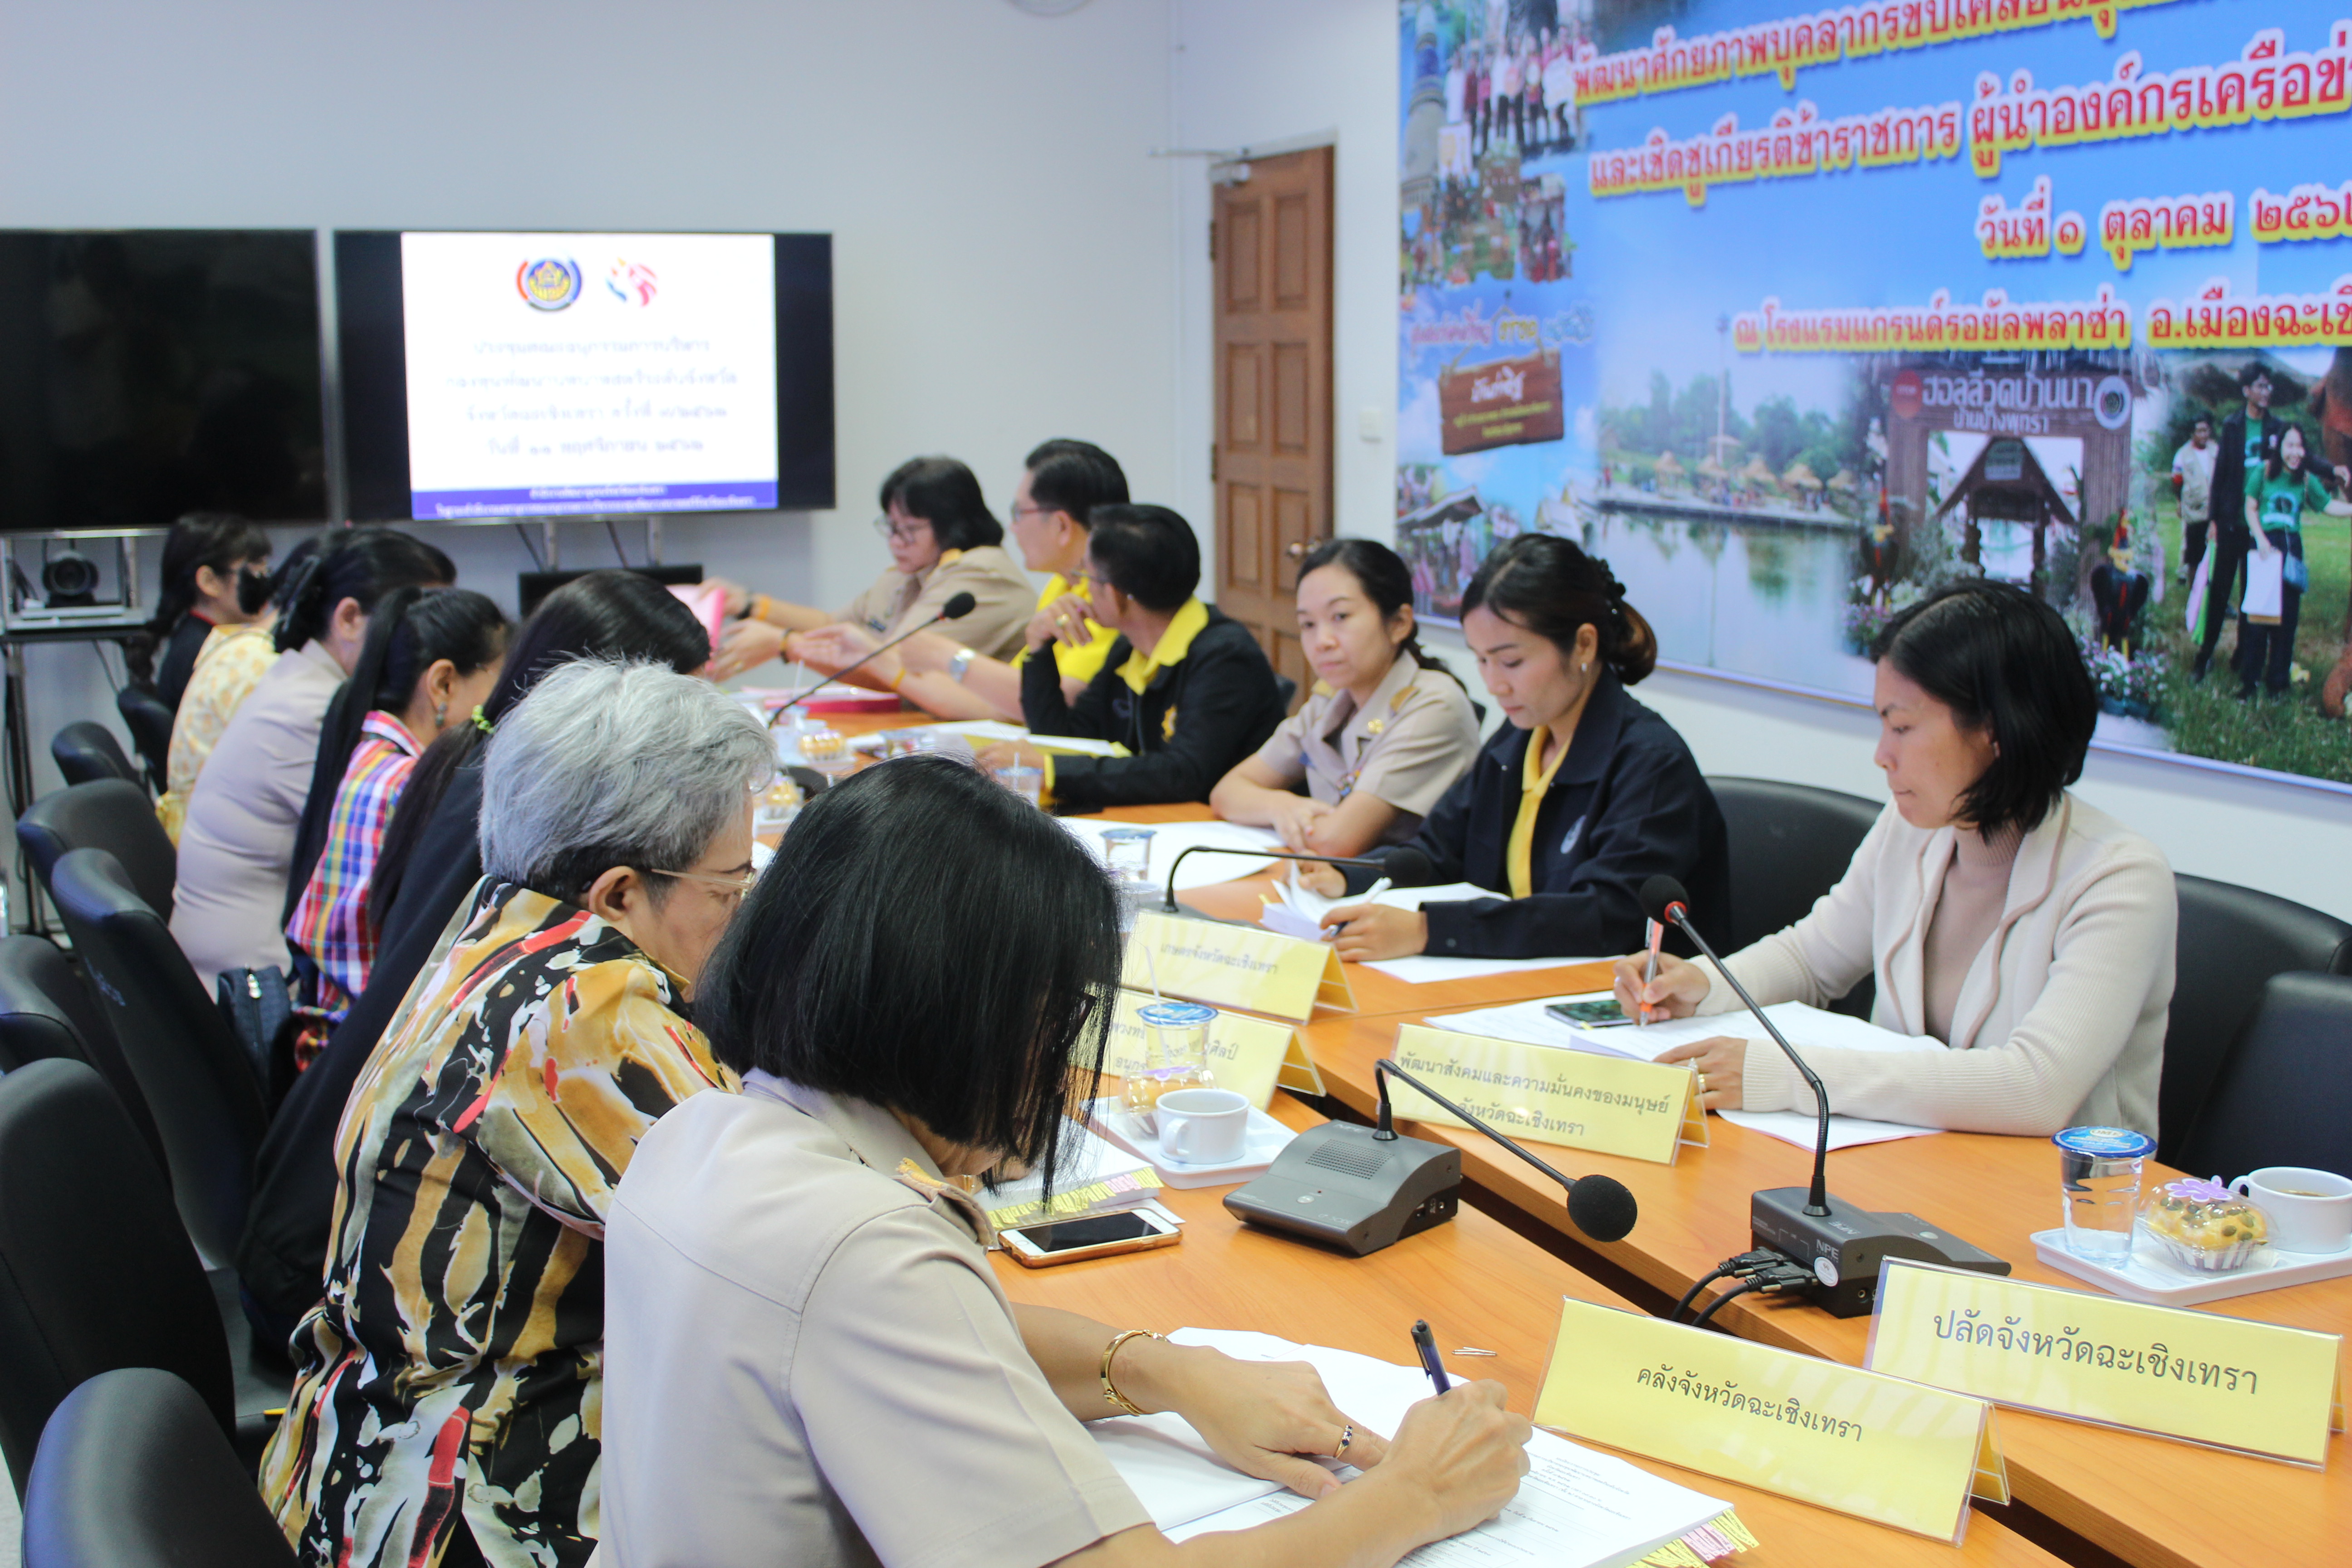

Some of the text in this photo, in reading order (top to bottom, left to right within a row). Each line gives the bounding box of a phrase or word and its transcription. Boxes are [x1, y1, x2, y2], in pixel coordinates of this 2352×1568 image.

[1591, 30, 2352, 198] และเชิดชูเกียรติข้าราชการ ผู้นำองค์กรเครือข่
[1980, 185, 2045, 250] วันที่
[2057, 221, 2079, 245] ๑
[2104, 199, 2227, 260] ตุลาคม
[1763, 293, 2126, 345] โรงแรมแกรนด์รอยัลพลาซ่า
[1400, 1051, 1671, 1115] พัฒนาสังคมและความมั่นคงของมนุษย์
[1816, 1239, 1839, 1260] NPE
[1933, 1308, 2259, 1396] ปลัดจังหวัดฉะเชิงเทรา
[1637, 1362, 1864, 1443] คลังจังหวัดฉะเชิงเทรา
